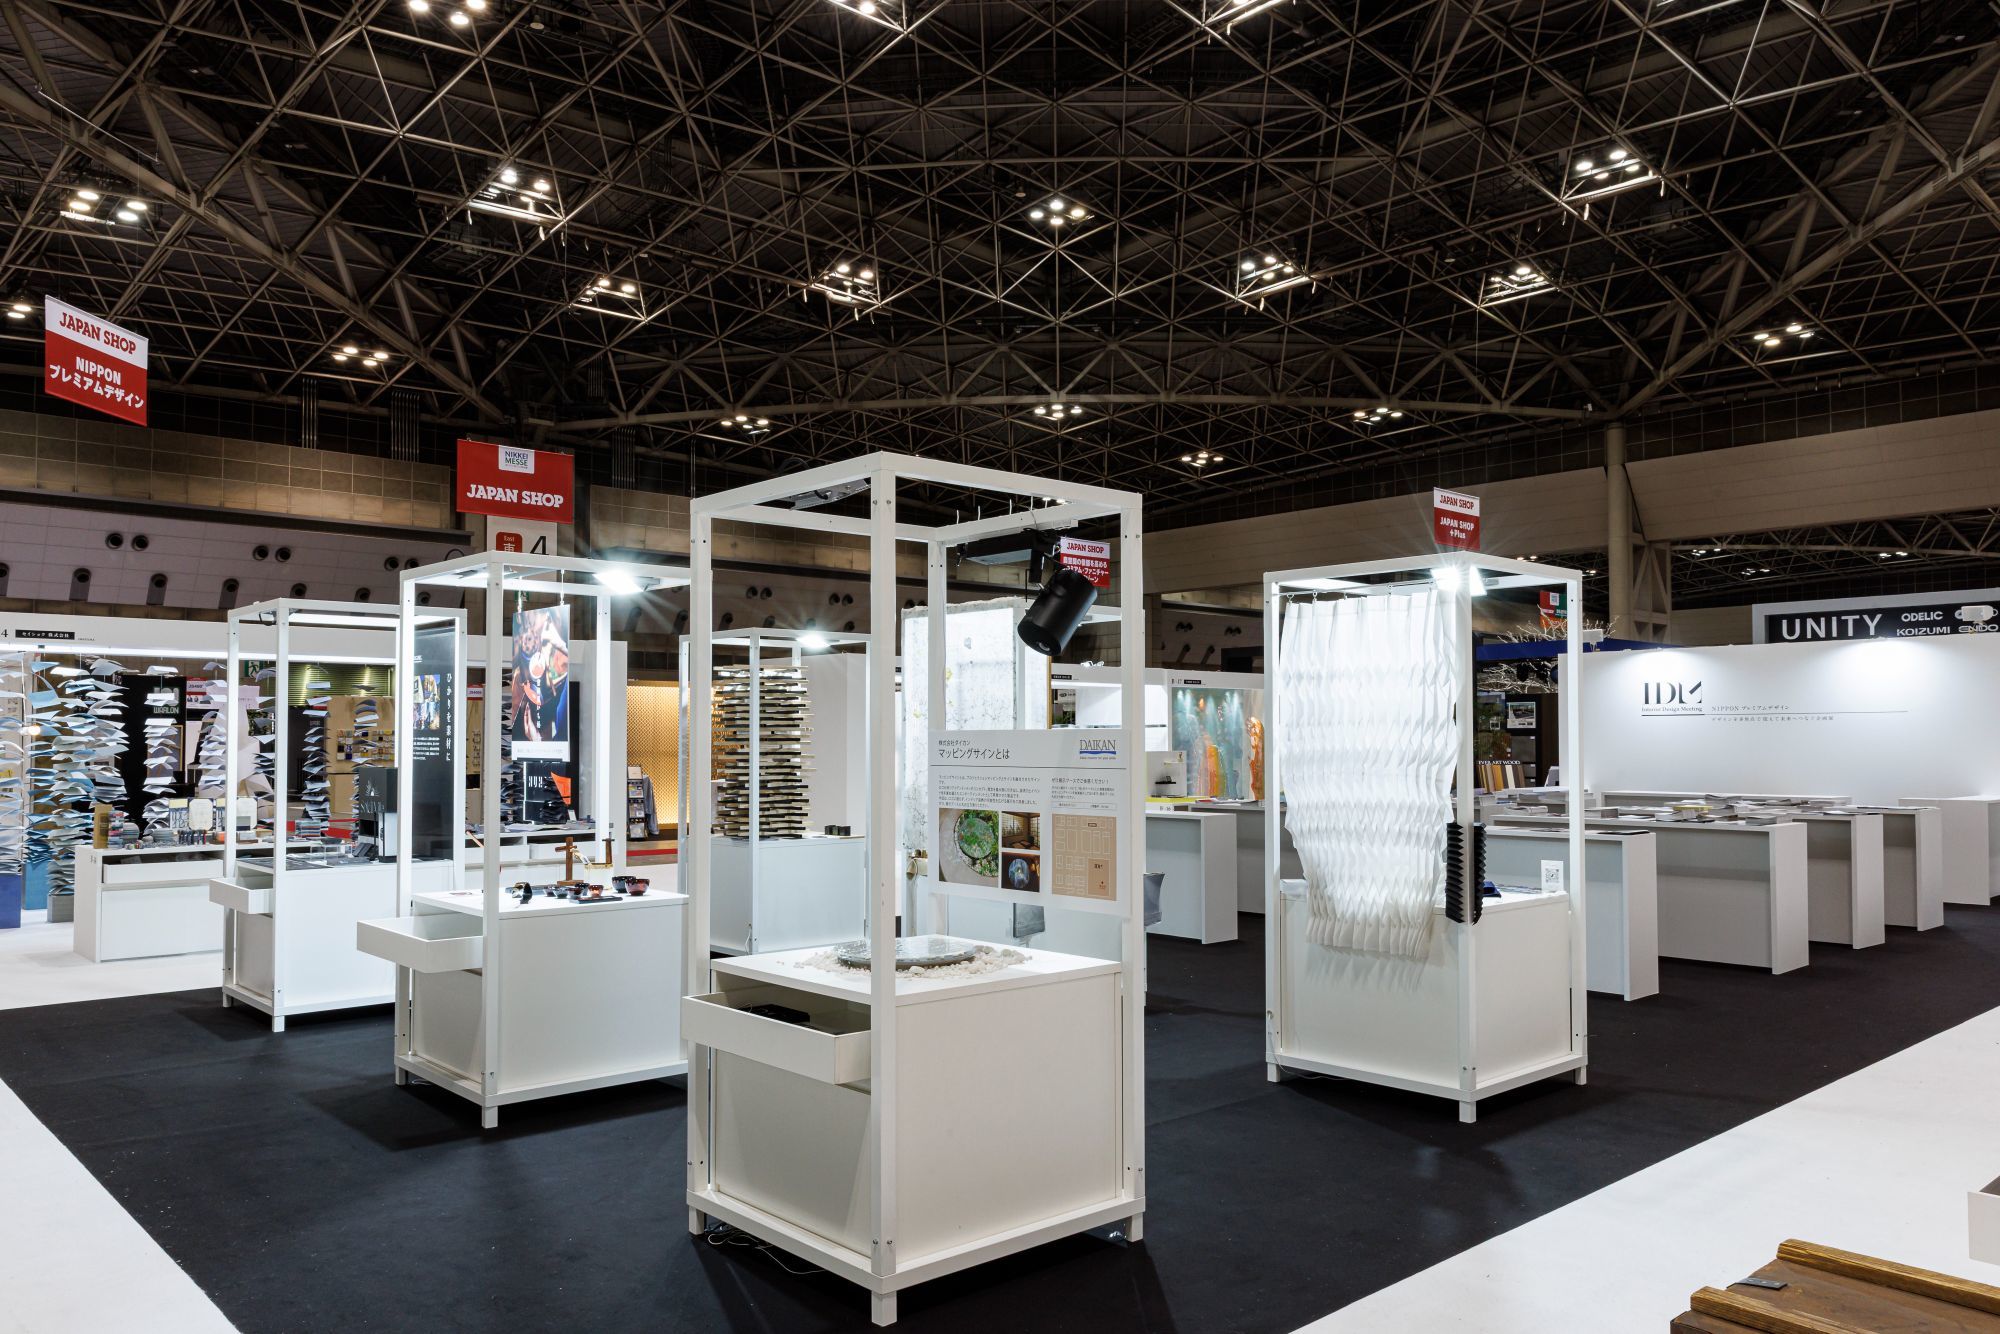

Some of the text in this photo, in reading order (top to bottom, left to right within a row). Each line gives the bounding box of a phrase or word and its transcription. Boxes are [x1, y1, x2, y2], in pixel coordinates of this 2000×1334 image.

[59, 312, 136, 354] JAPAN SHOP
[75, 356, 121, 385] NIPPON
[49, 364, 144, 409] プレミアムデザイン
[504, 450, 528, 460] NIKKEI
[504, 457, 528, 467] MESSE
[466, 483, 563, 508] JAPAN SHOP
[1440, 494, 1474, 510] JAPAN SHOP
[1440, 516, 1474, 532] JAPAN SHOP
[1066, 542, 1105, 554] JAPAN SHOP
[1901, 611, 1943, 622] ODELIC
[1781, 613, 1883, 640] UNITY
[1896, 626, 1951, 637] KOIZUMI
[1079, 739, 1116, 751] DAIKAN
[938, 747, 1010, 760] マッピングサインとは
